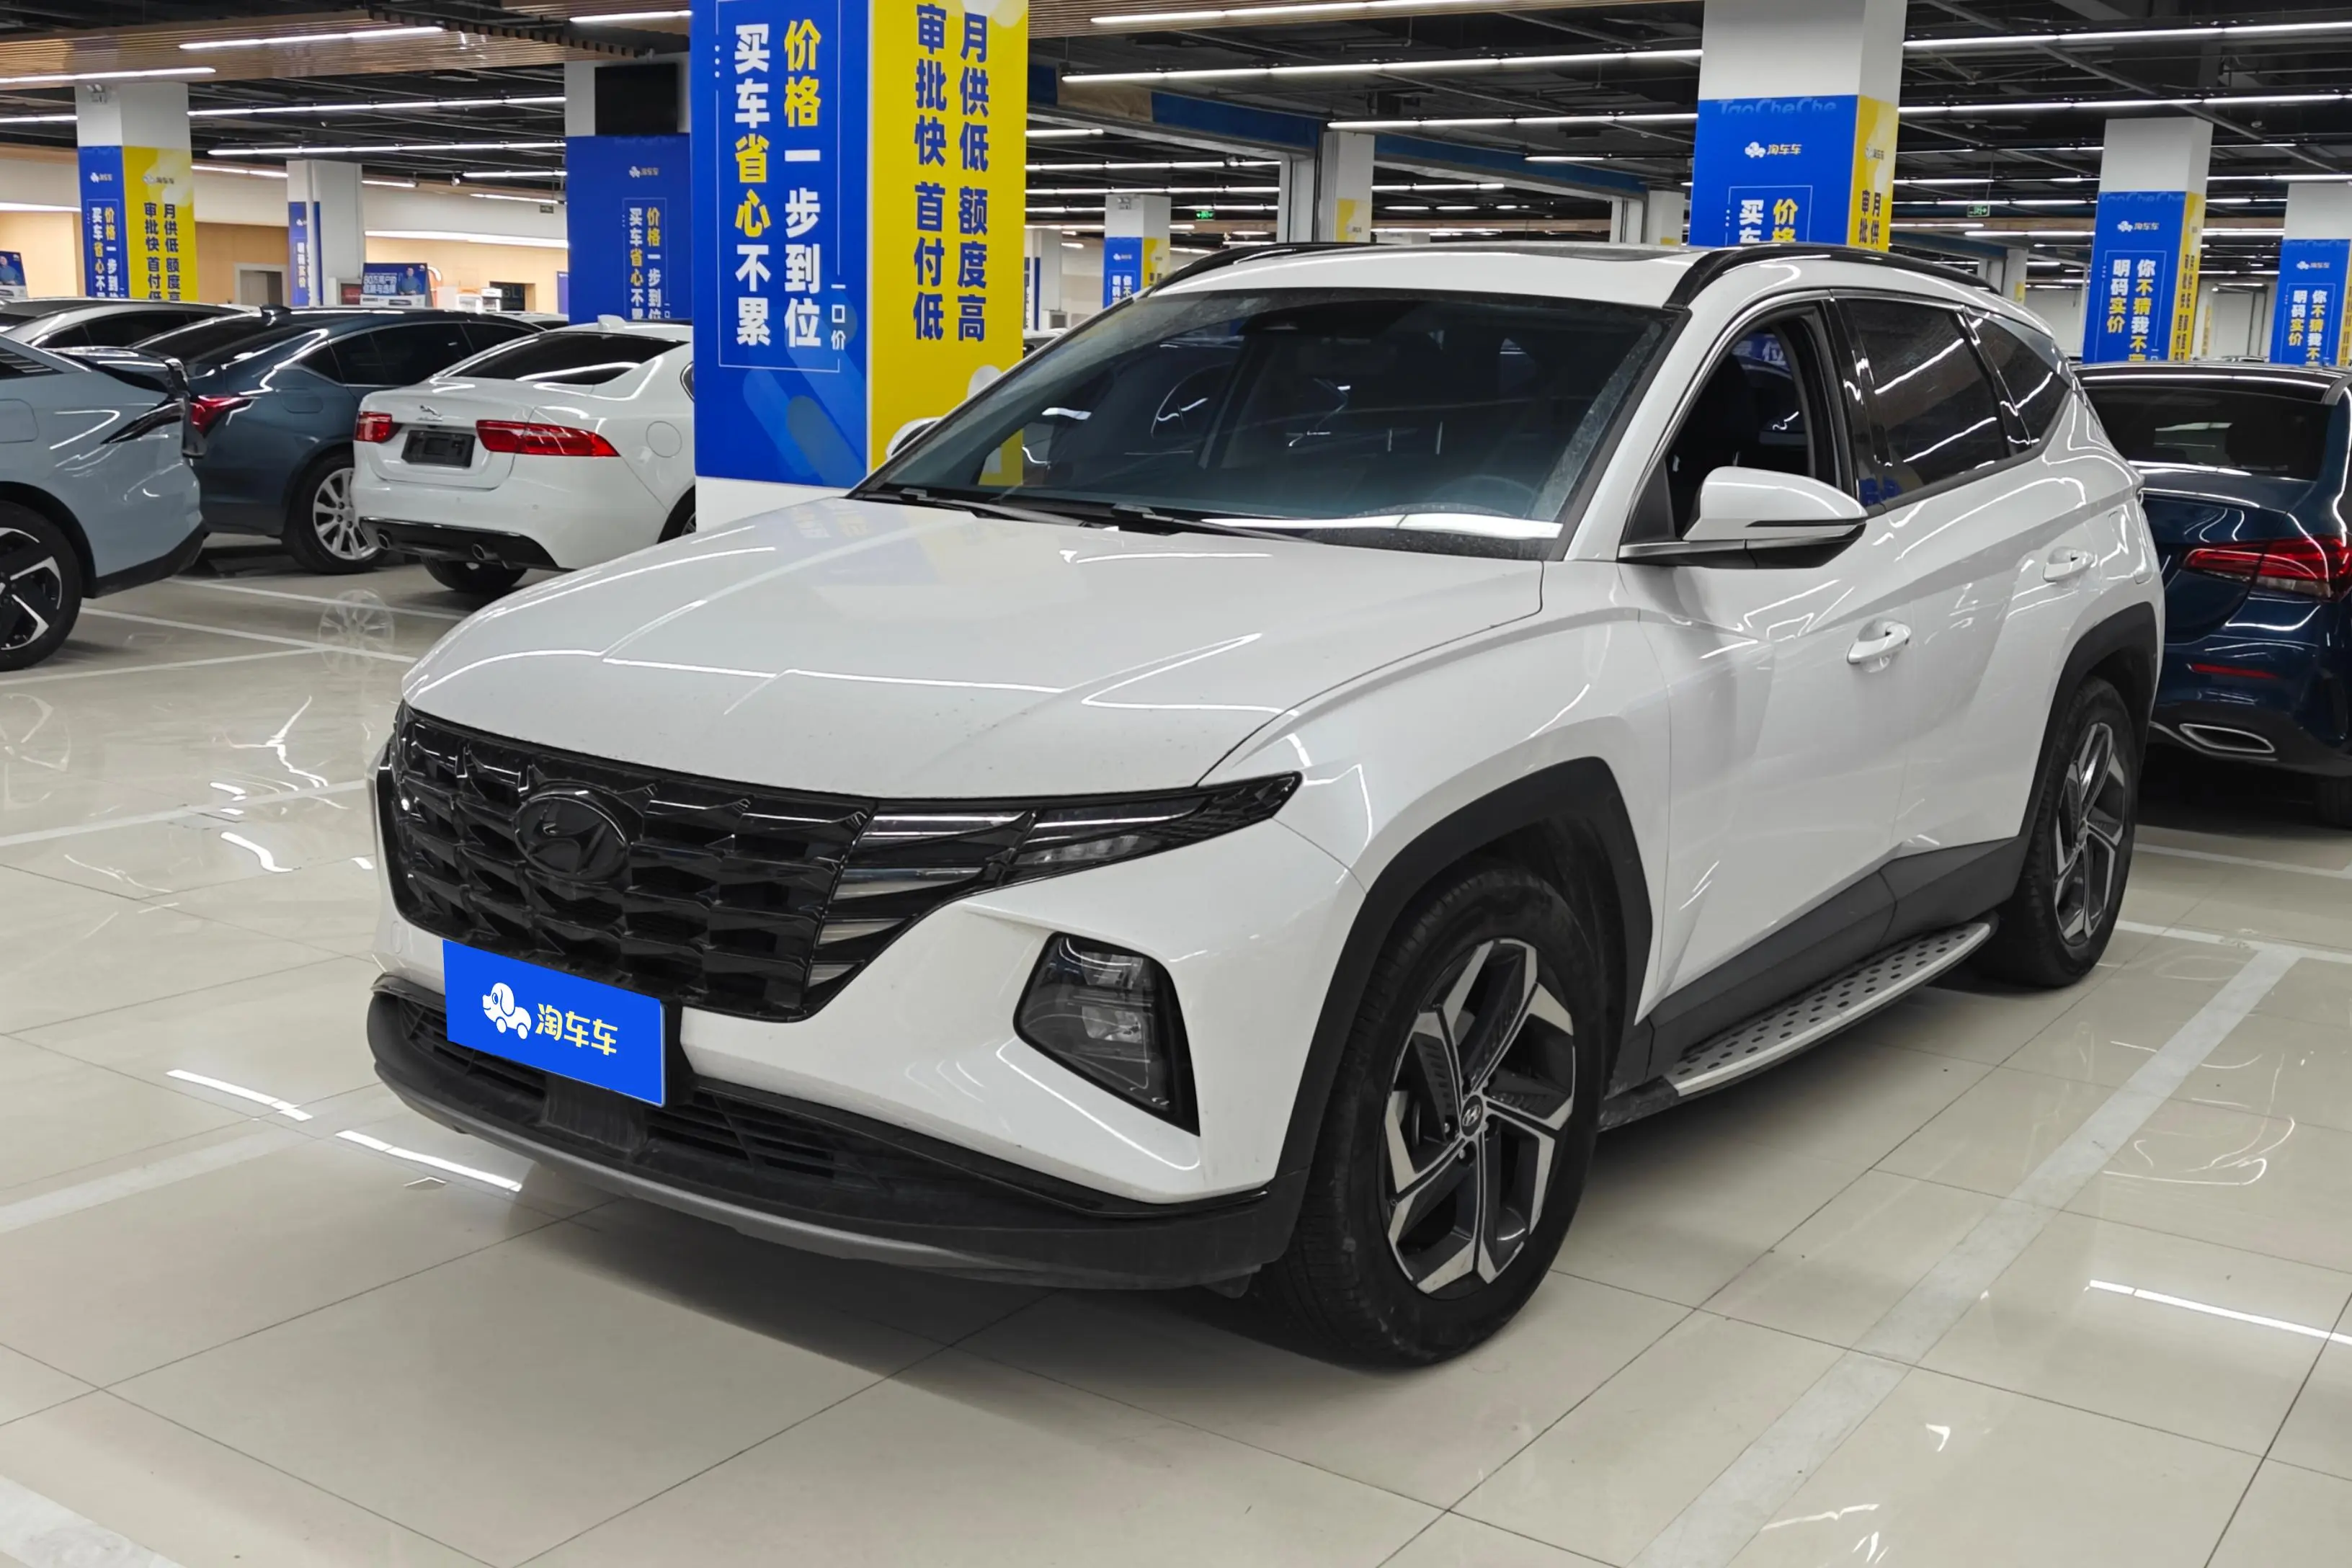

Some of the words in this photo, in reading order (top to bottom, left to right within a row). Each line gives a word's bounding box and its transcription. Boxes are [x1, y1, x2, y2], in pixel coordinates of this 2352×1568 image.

[914, 3, 947, 167] 审批快
[960, 12, 989, 172] 月供低
[1768, 144, 1801, 155] 淘车车
[734, 24, 772, 346] 买车省心不累
[784, 19, 821, 347] 价格一步到位
[913, 181, 945, 341] 首付低
[831, 284, 846, 350] 一口价
[957, 186, 988, 342] 额度高
[2106, 259, 2132, 334] 明码实价
